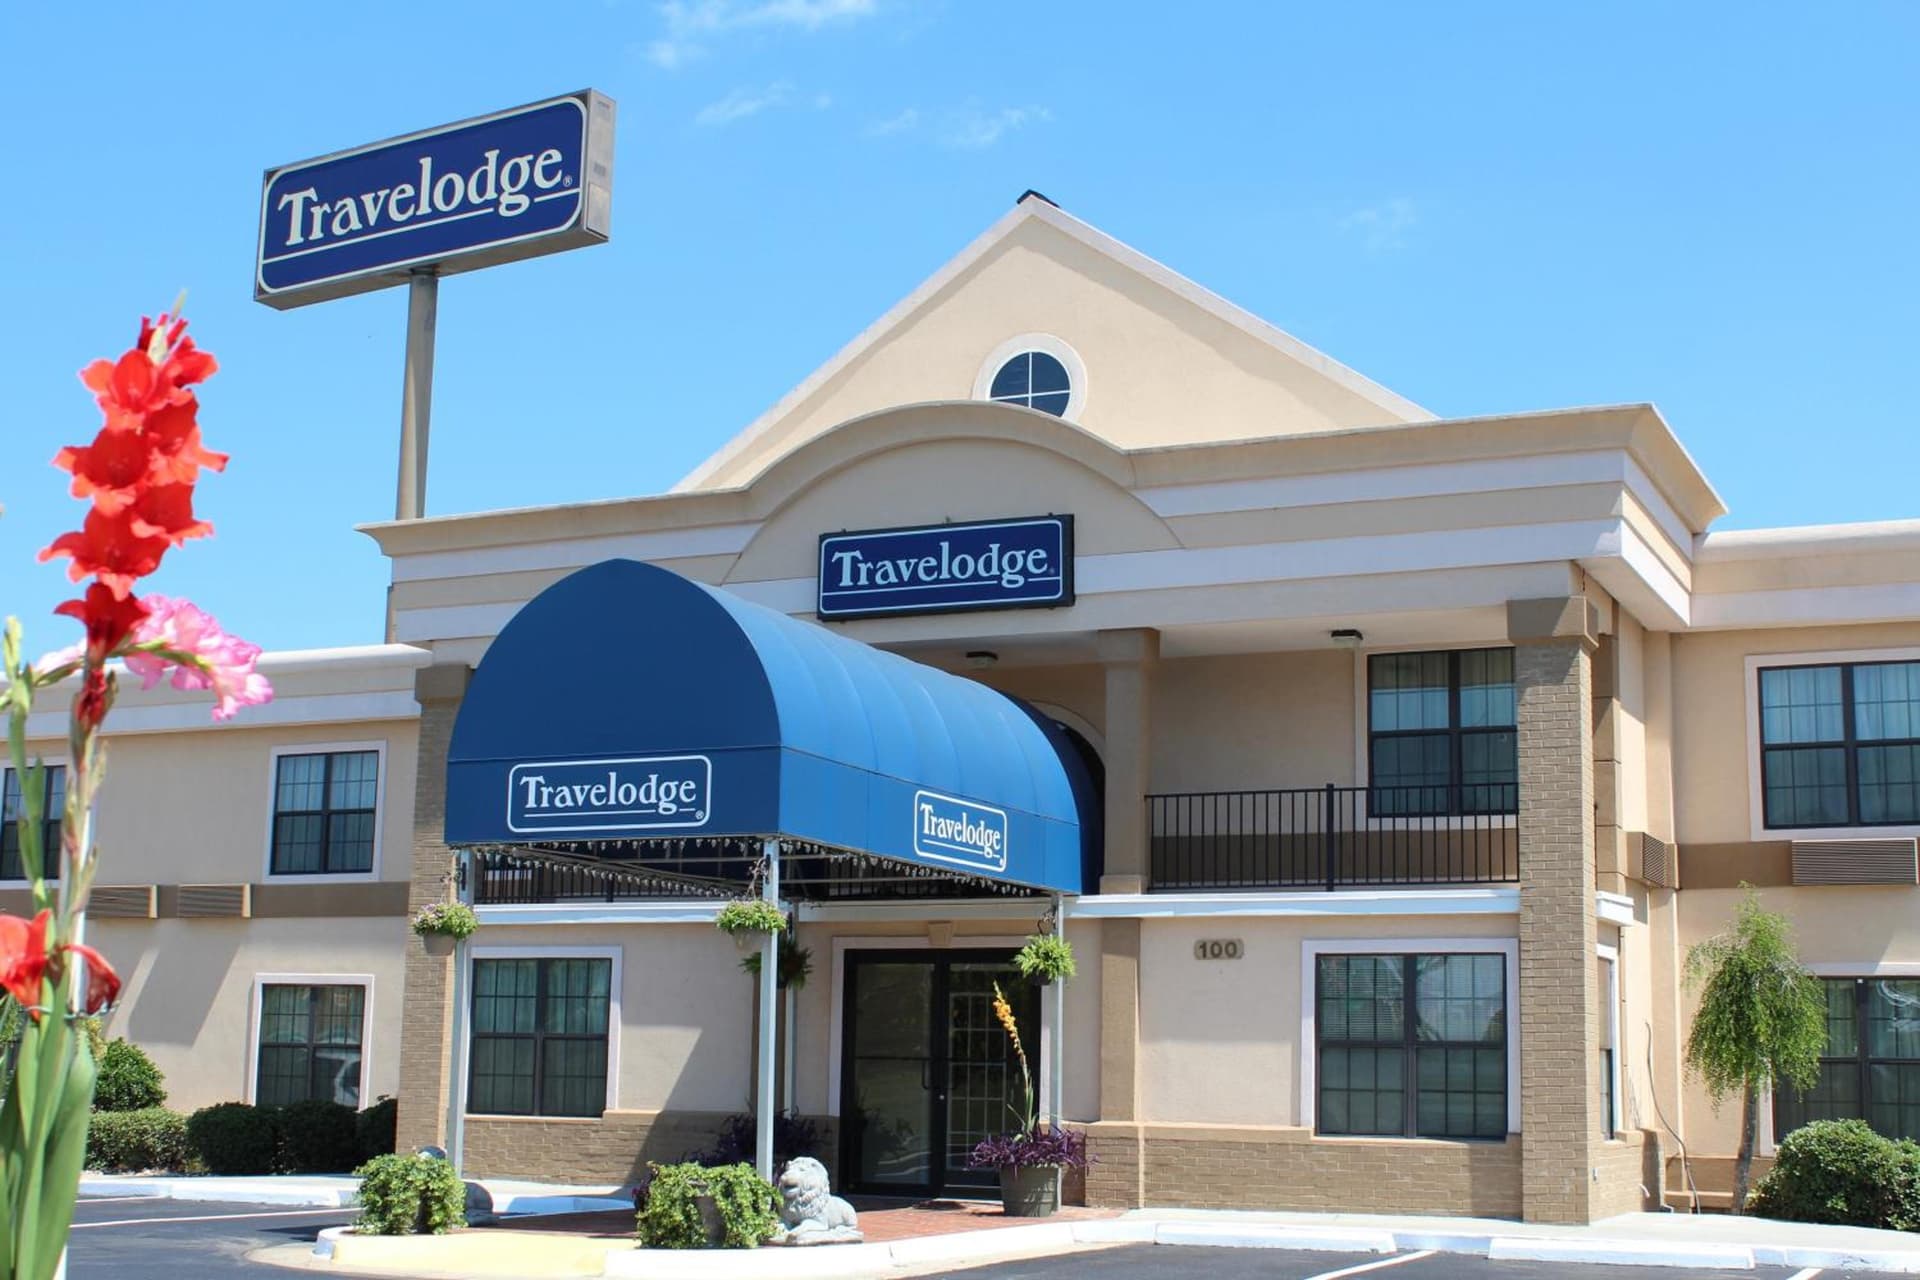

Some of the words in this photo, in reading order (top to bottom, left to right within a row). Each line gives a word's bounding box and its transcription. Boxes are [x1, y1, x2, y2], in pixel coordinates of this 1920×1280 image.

[277, 148, 563, 247] Travelodge
[831, 541, 1048, 589] Travelodge
[519, 771, 697, 815] Travelodge
[920, 802, 1001, 859] Travelodge
[1199, 941, 1238, 959] 100
